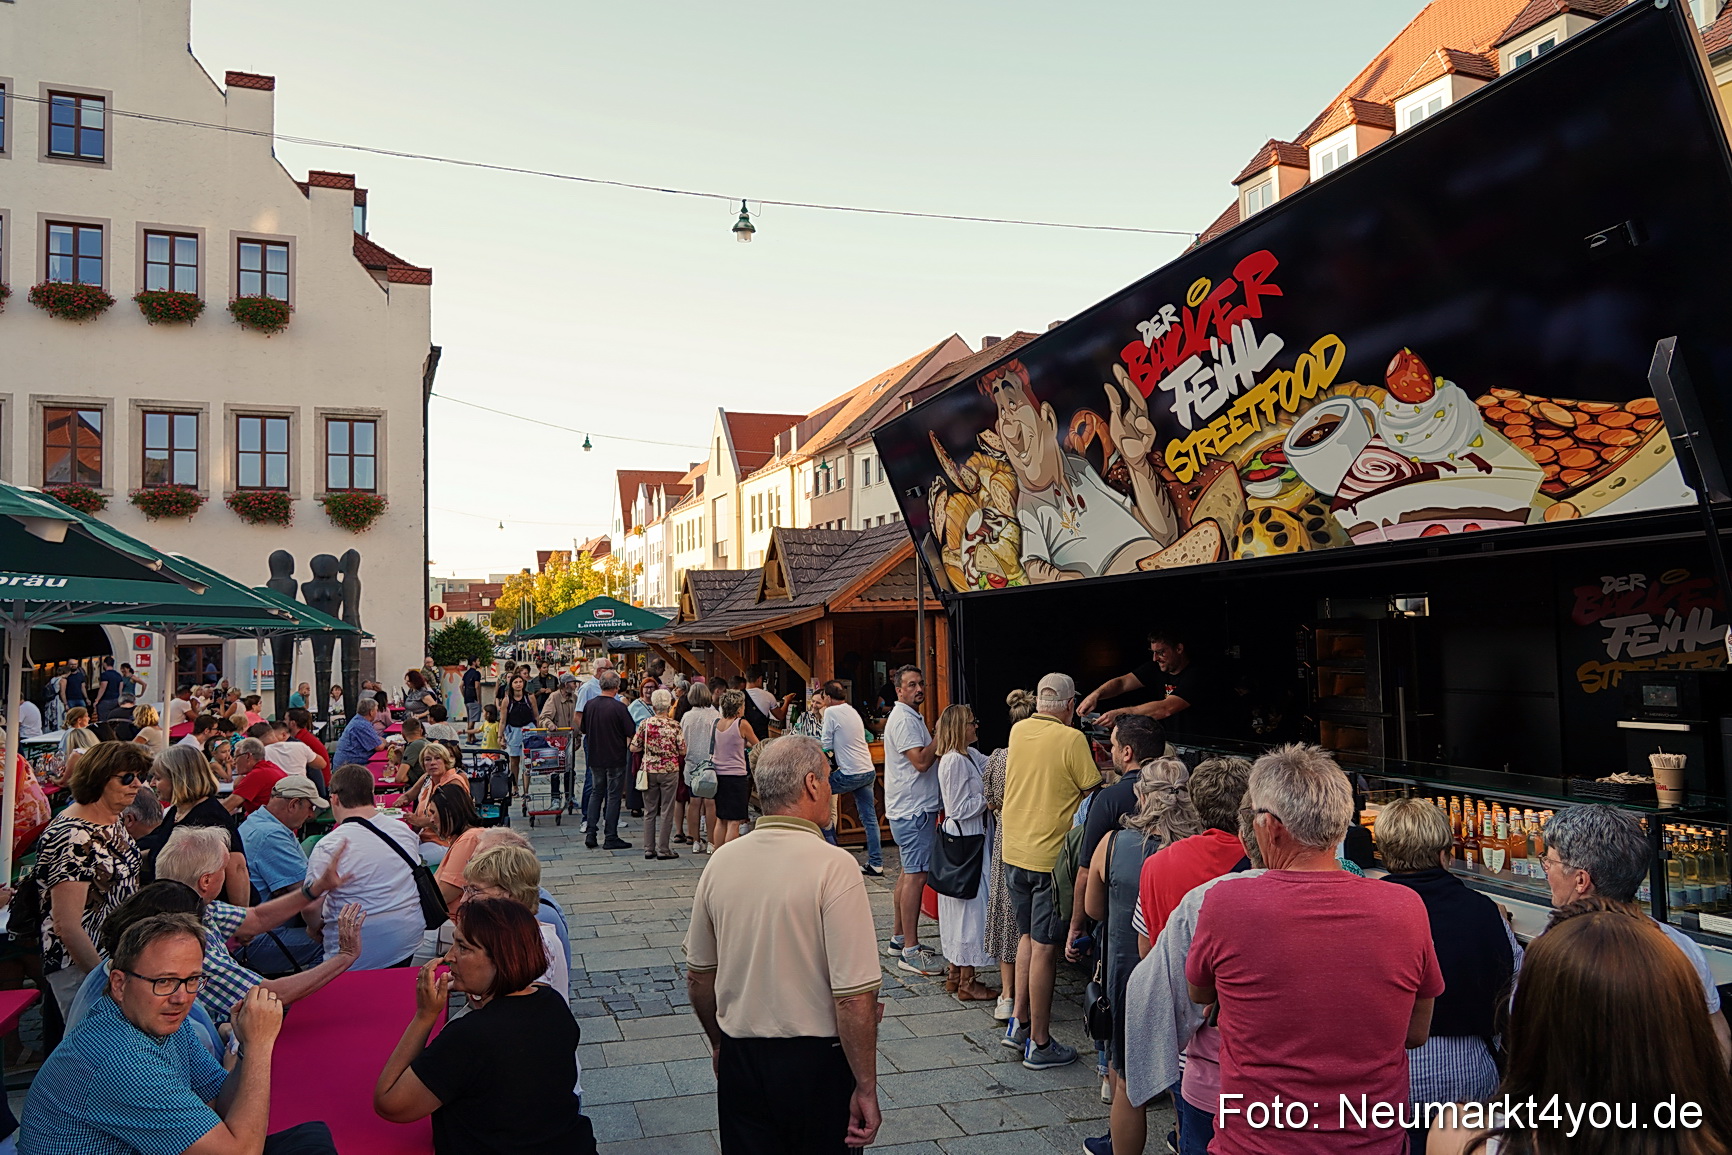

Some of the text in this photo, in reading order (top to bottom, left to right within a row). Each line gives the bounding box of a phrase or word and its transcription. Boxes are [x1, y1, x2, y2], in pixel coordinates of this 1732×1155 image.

[1136, 304, 1180, 348] DER
[1165, 333, 1346, 484] STREETFOOD
[1600, 573, 1647, 595] DER
